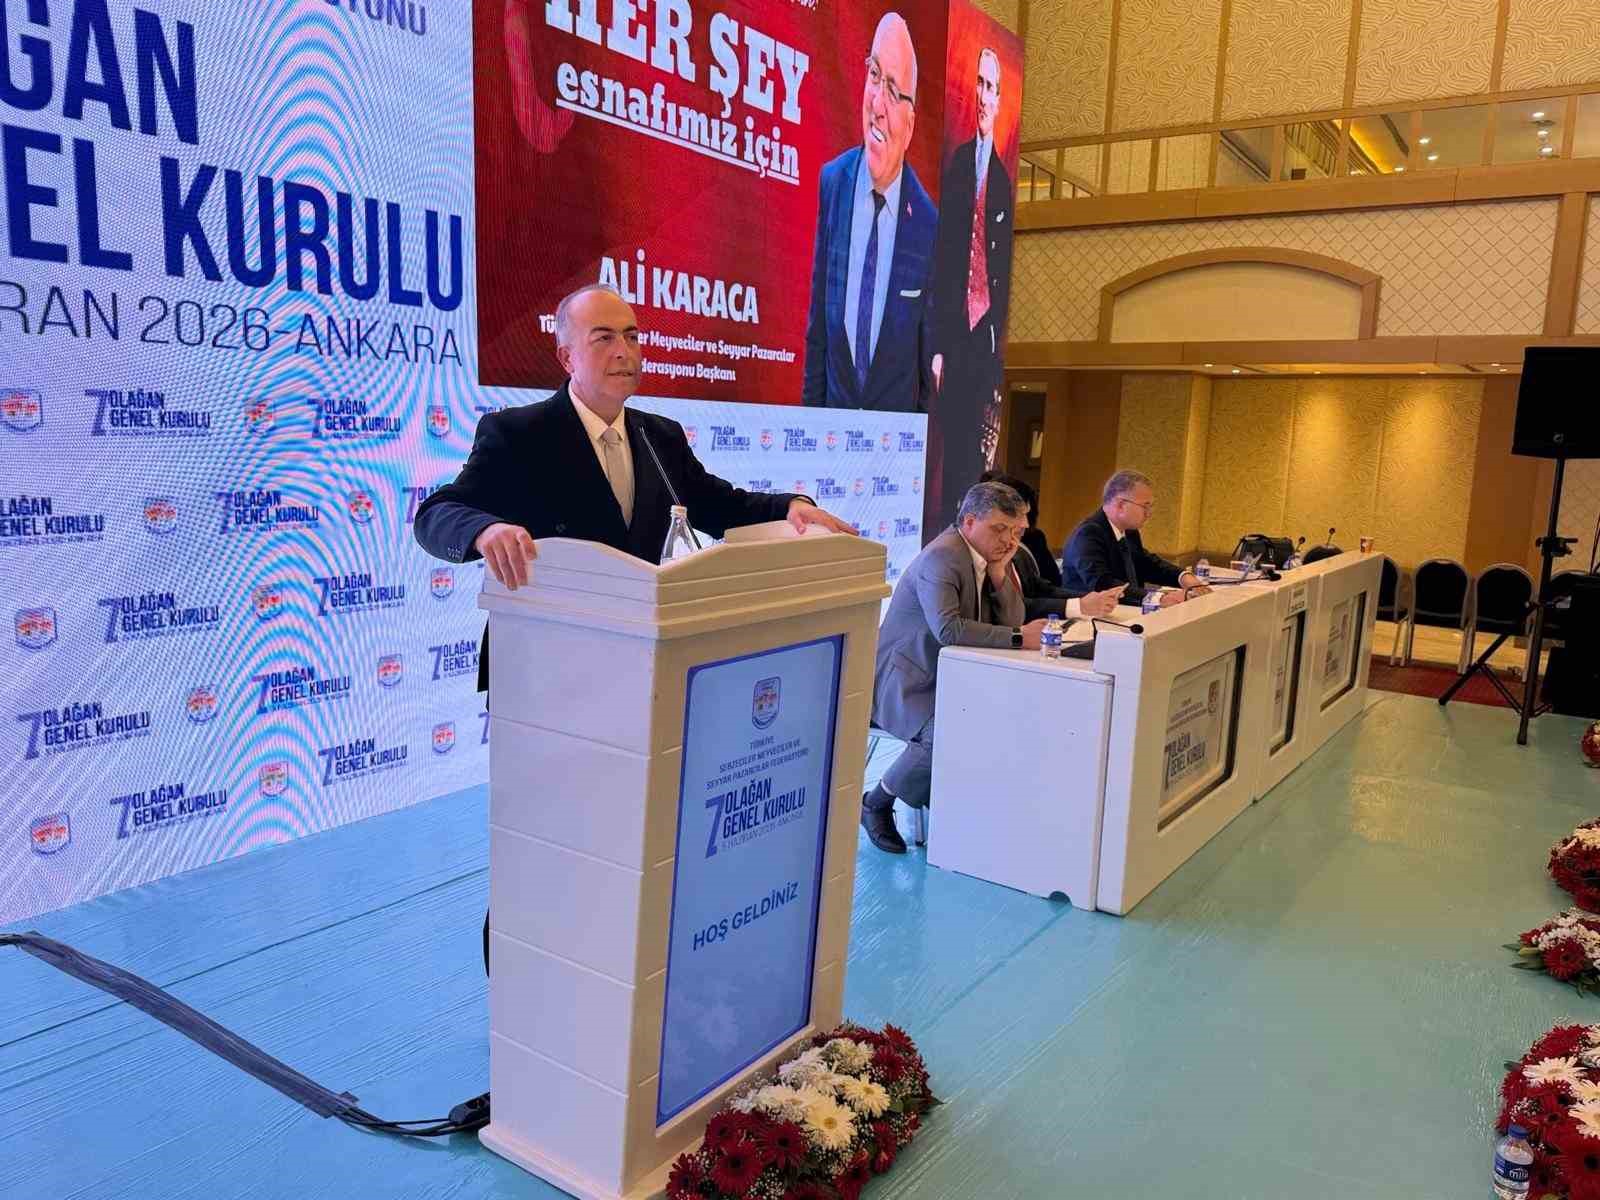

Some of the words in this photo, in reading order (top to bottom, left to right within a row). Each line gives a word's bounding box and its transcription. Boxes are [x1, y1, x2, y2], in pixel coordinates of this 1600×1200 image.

[709, 12, 809, 125] ŞEY
[557, 62, 738, 157] esnafımız
[743, 116, 799, 178] için
[2, 124, 133, 271] EL
[160, 156, 464, 312] KURULU
[598, 248, 646, 306] ALİ
[652, 267, 759, 324] KARACA
[650, 332, 704, 354] Meyveciler
[706, 344, 717, 355] ve
[718, 342, 752, 360] Seyyar
[697, 363, 736, 383] Başkanı
[723, 805, 760, 839] GENEL
[763, 786, 806, 823] KURULU
[725, 778, 772, 815] OLAĞAN
[693, 918, 729, 952] HOŞ
[732, 881, 799, 930] GELDİNİZ
